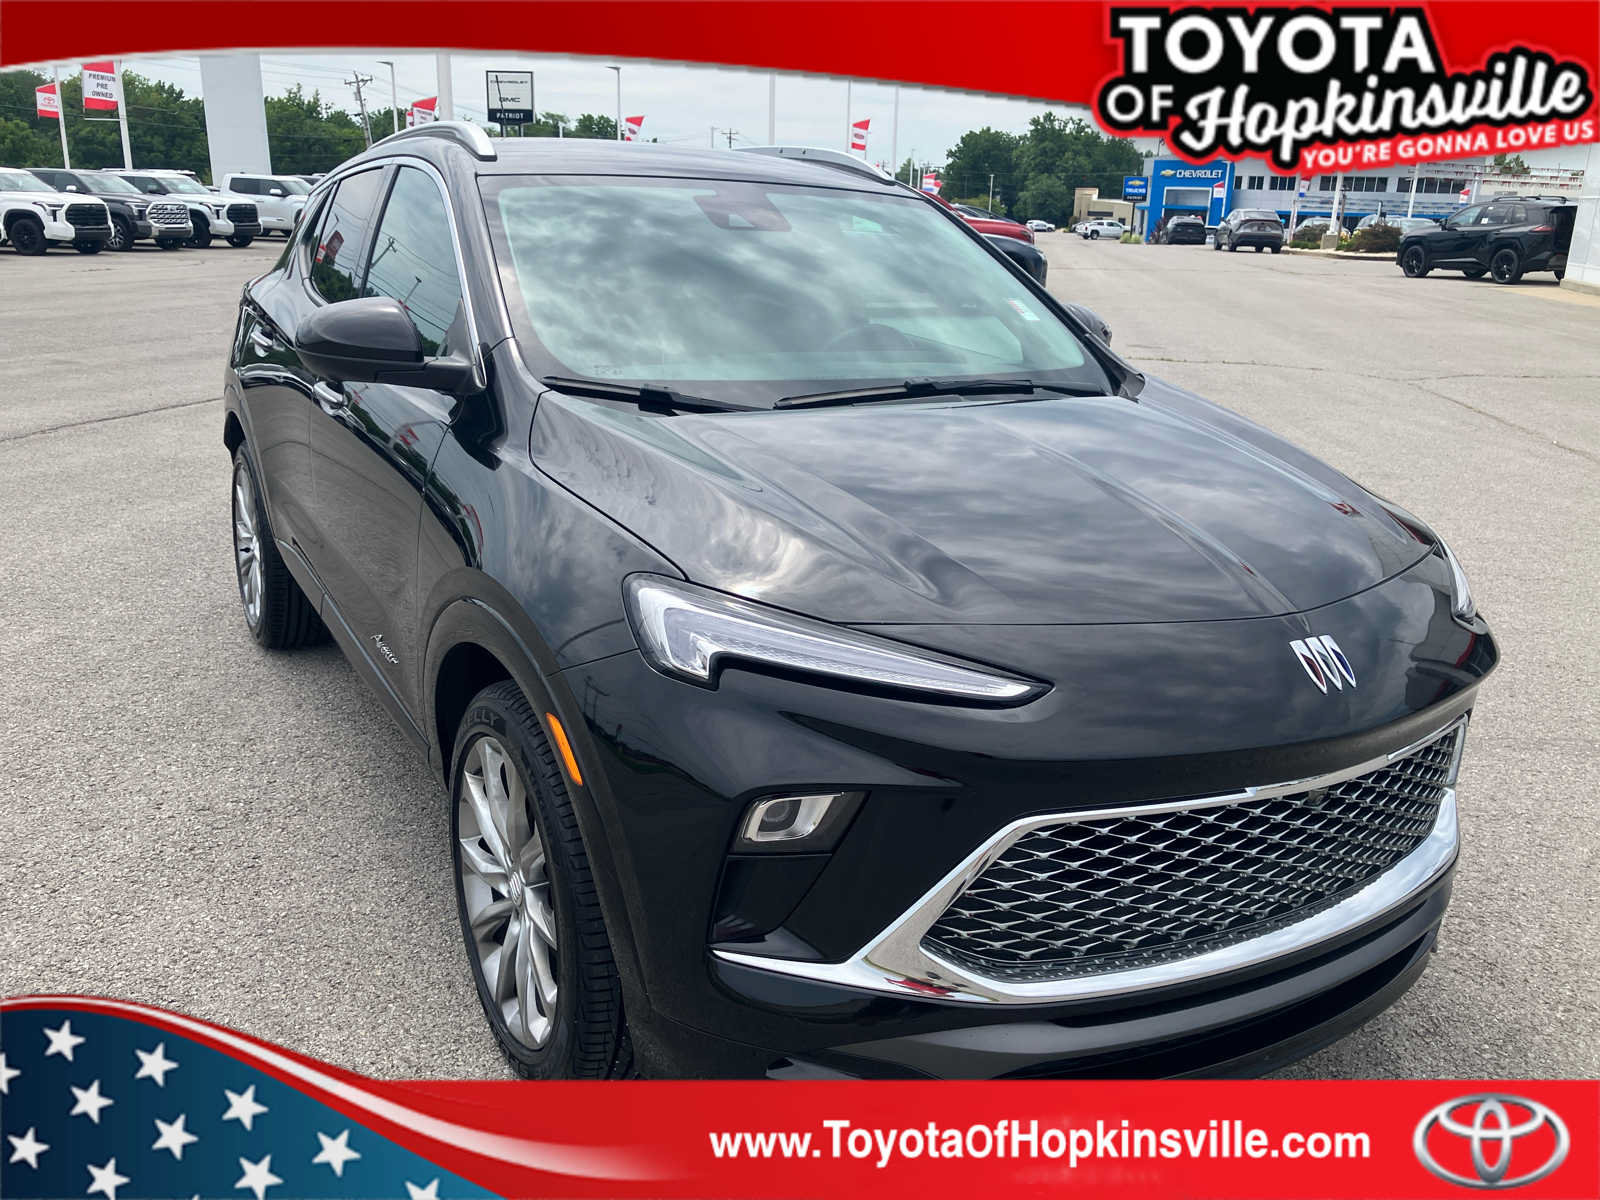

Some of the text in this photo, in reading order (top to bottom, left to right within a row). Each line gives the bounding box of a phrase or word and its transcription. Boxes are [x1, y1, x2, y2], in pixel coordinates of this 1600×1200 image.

[88, 73, 116, 82] PREMIUM
[96, 82, 108, 90] PRE
[91, 90, 113, 98] OWNED
[1176, 169, 1223, 178] CHEVROLET
